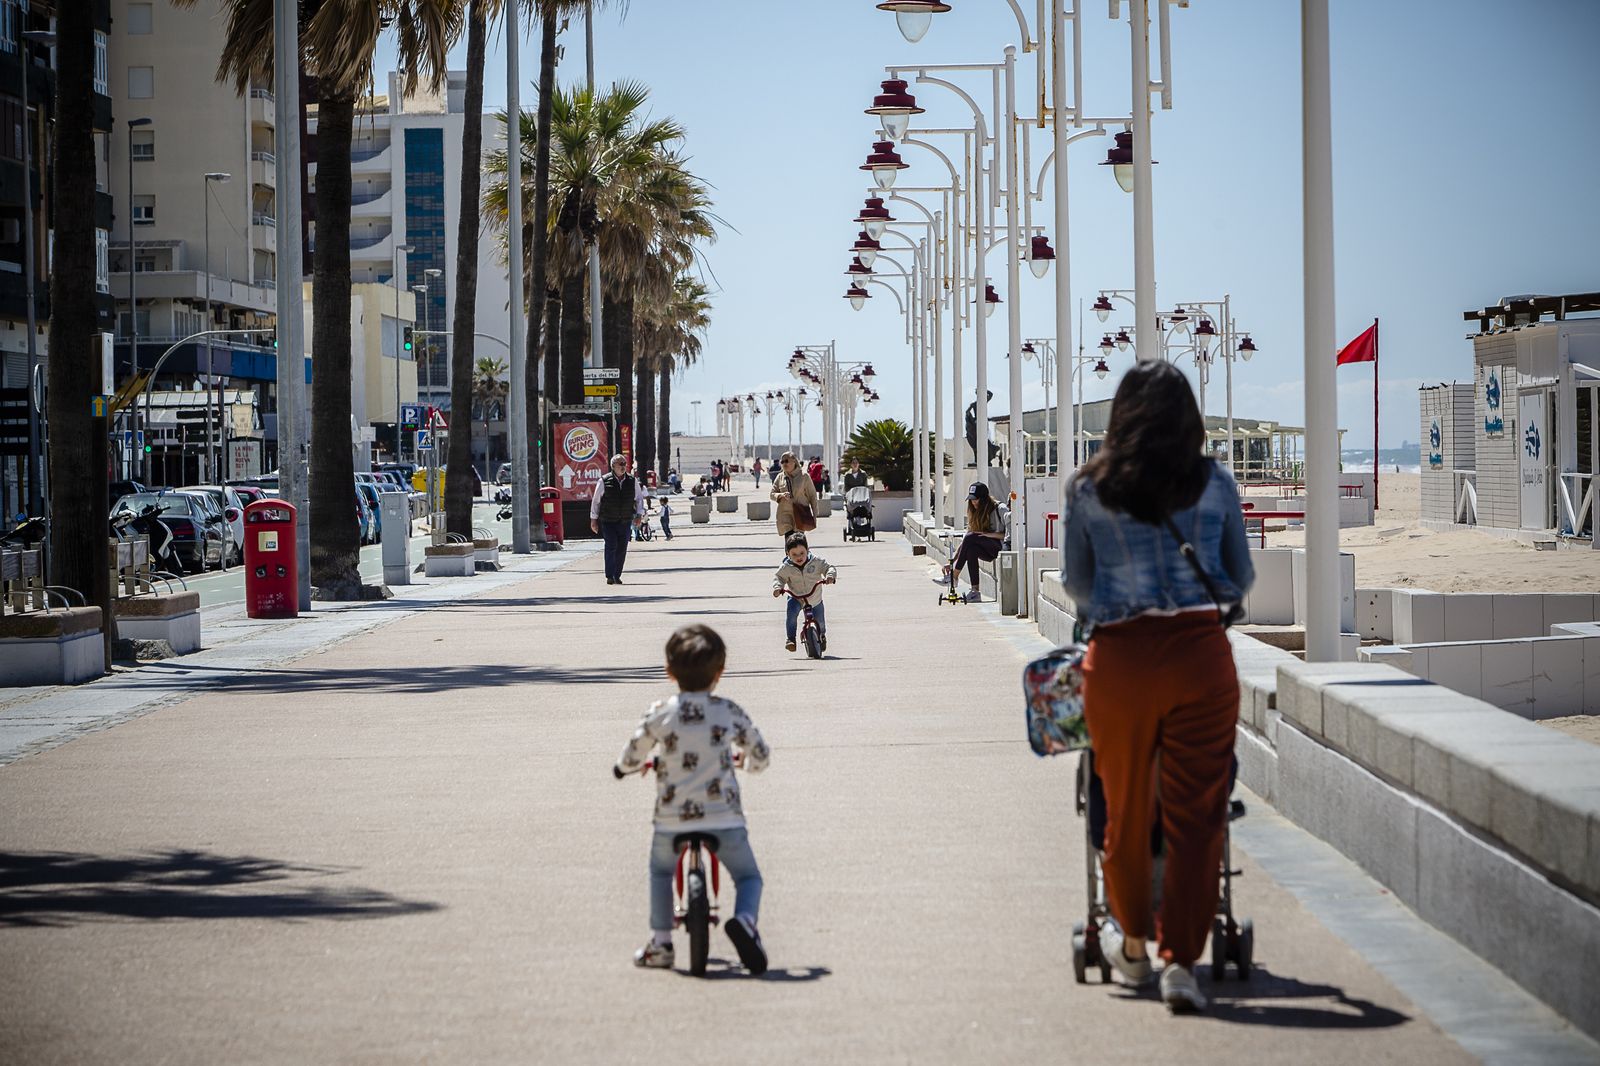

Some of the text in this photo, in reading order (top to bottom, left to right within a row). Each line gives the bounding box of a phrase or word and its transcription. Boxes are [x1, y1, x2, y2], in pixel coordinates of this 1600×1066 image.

[405, 408, 416, 423] P
[568, 433, 593, 446] BURGER
[569, 439, 595, 454] KING
[585, 469, 602, 479] MIN
